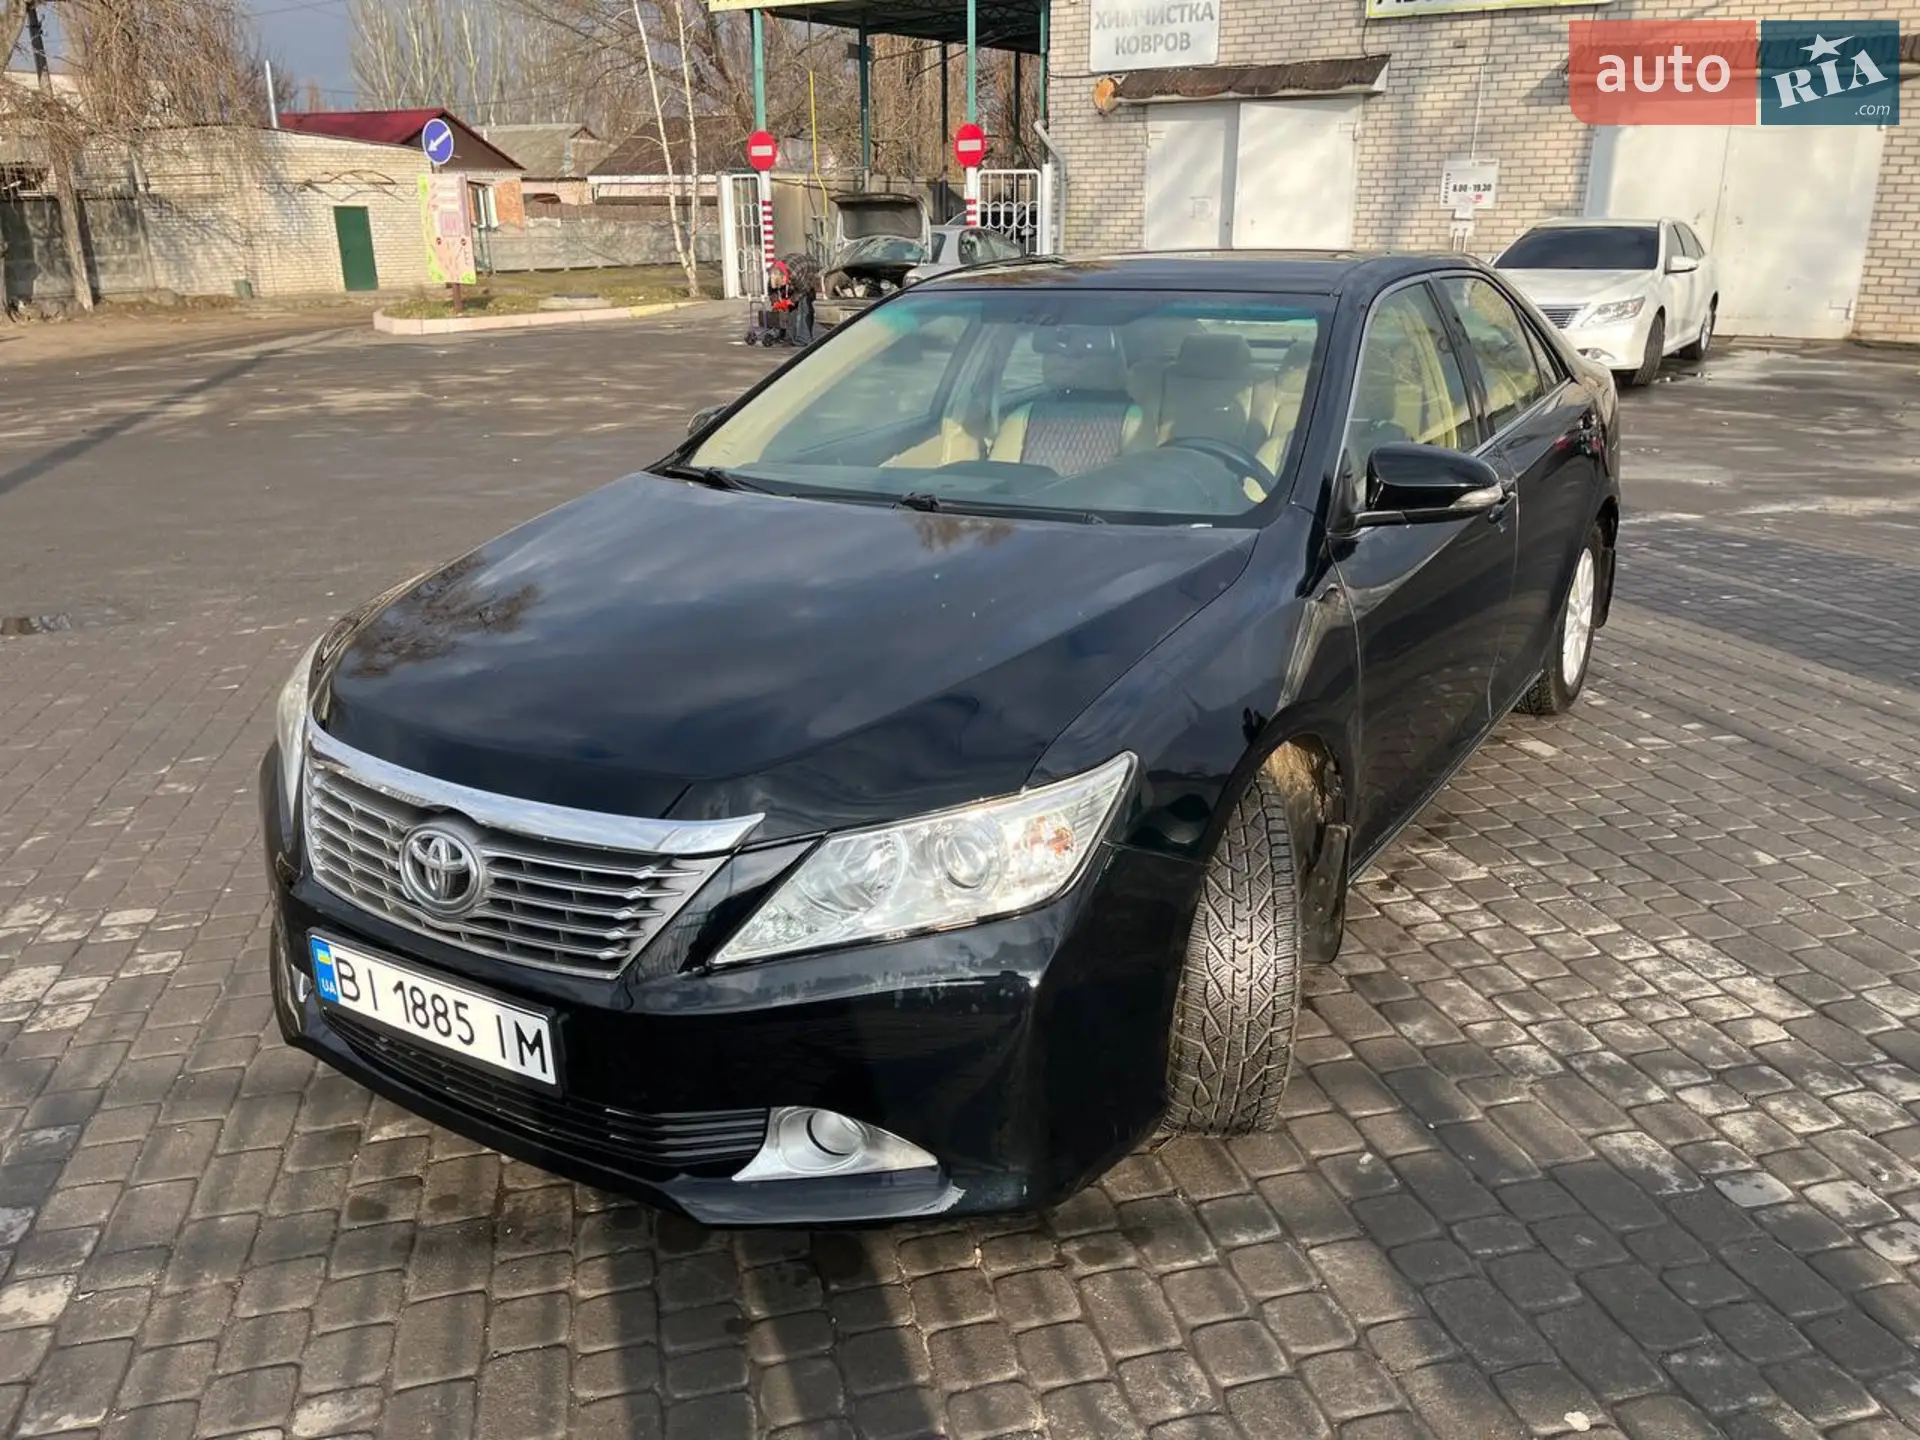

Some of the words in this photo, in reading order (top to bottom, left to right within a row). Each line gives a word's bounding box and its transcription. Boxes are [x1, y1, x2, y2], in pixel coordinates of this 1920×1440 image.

[1095, 2, 1214, 30] ХИМЧИСТКА
[1115, 32, 1191, 56] КОВРОВ
[321, 979, 337, 995] UA
[335, 957, 378, 1011] BI
[393, 980, 475, 1046] 1885
[496, 1014, 548, 1074] IM
